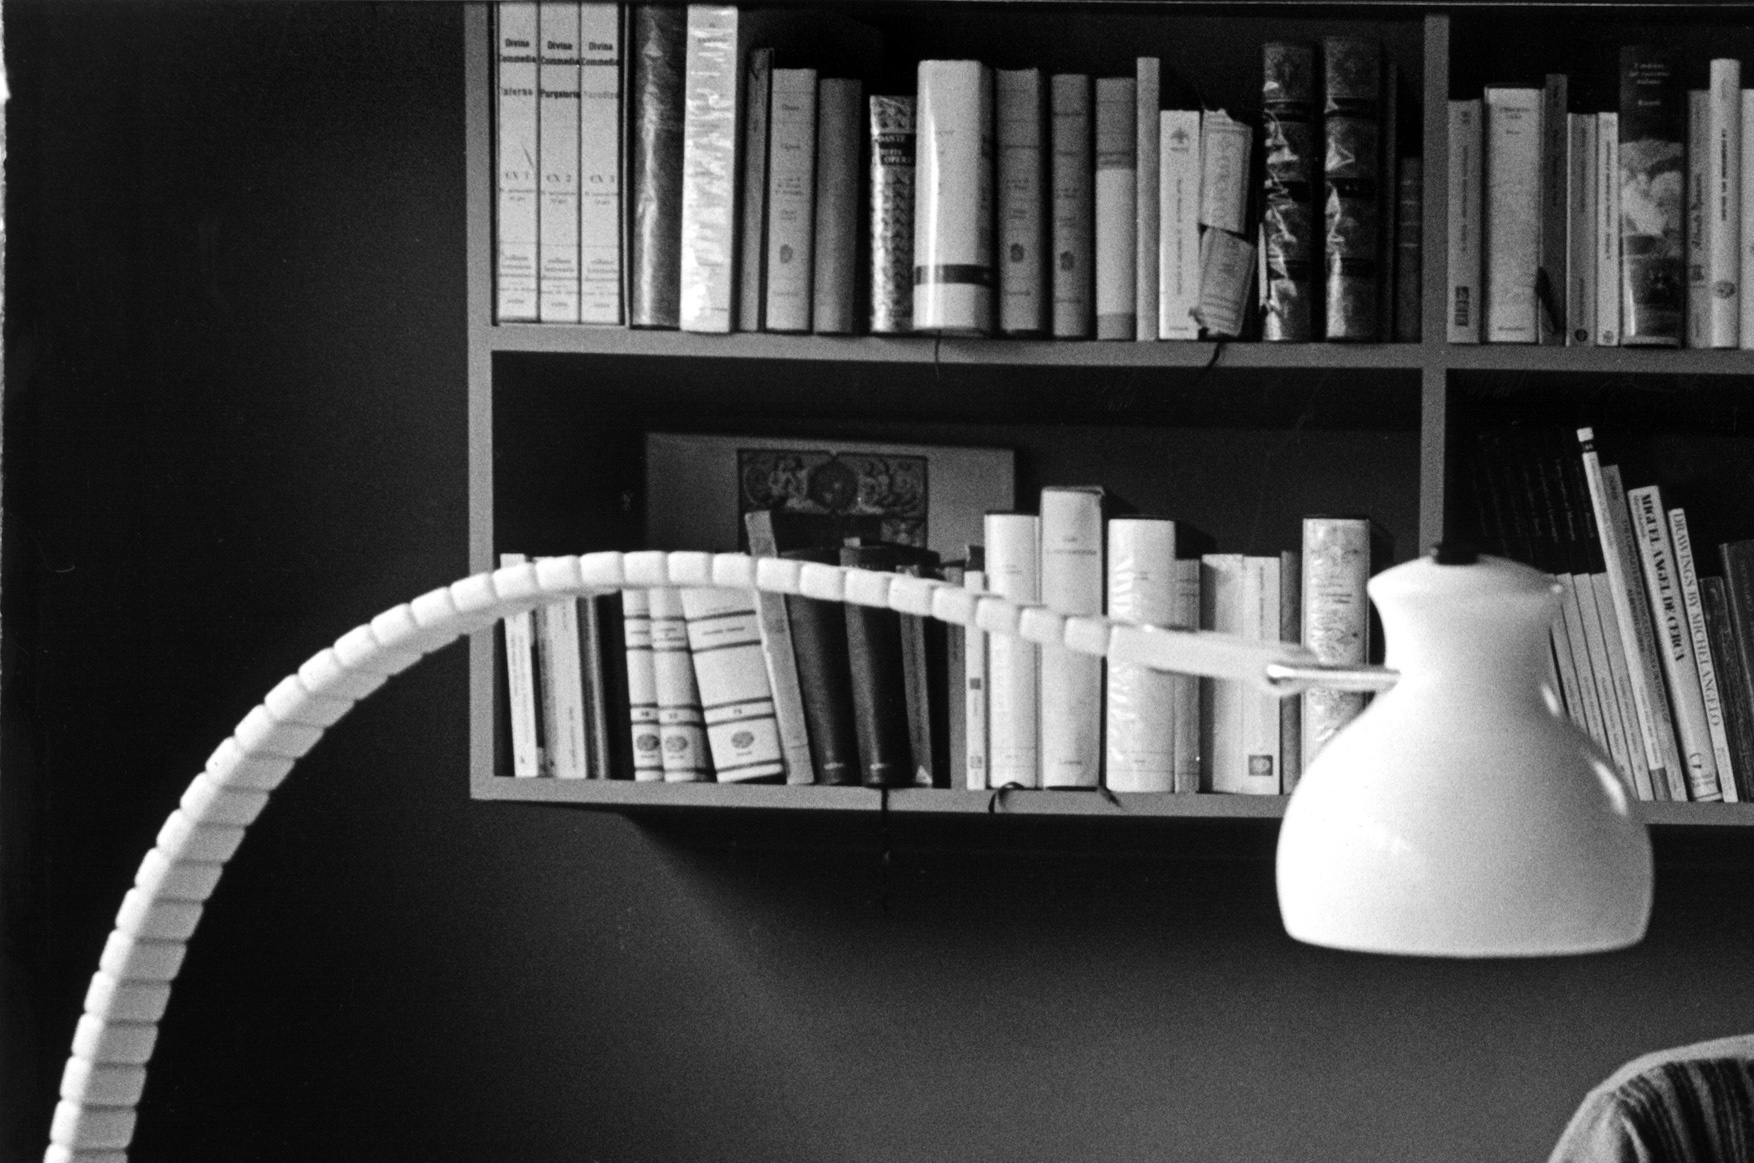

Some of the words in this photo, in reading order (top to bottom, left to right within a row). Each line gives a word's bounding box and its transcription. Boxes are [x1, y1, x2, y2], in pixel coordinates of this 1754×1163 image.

[505, 38, 530, 48] Divina
[547, 40, 573, 51] Divina
[588, 41, 613, 51] Divina
[500, 87, 533, 97] nferno
[1641, 494, 1660, 546] MIGUEL
[1673, 512, 1696, 588] DRAWINGS
[1653, 549, 1672, 595] ANGEL
[1662, 596, 1677, 617] DE
[1687, 591, 1698, 607] BY
[1668, 616, 1685, 662] CERCA
[1691, 613, 1721, 727] MICHELANGELO
